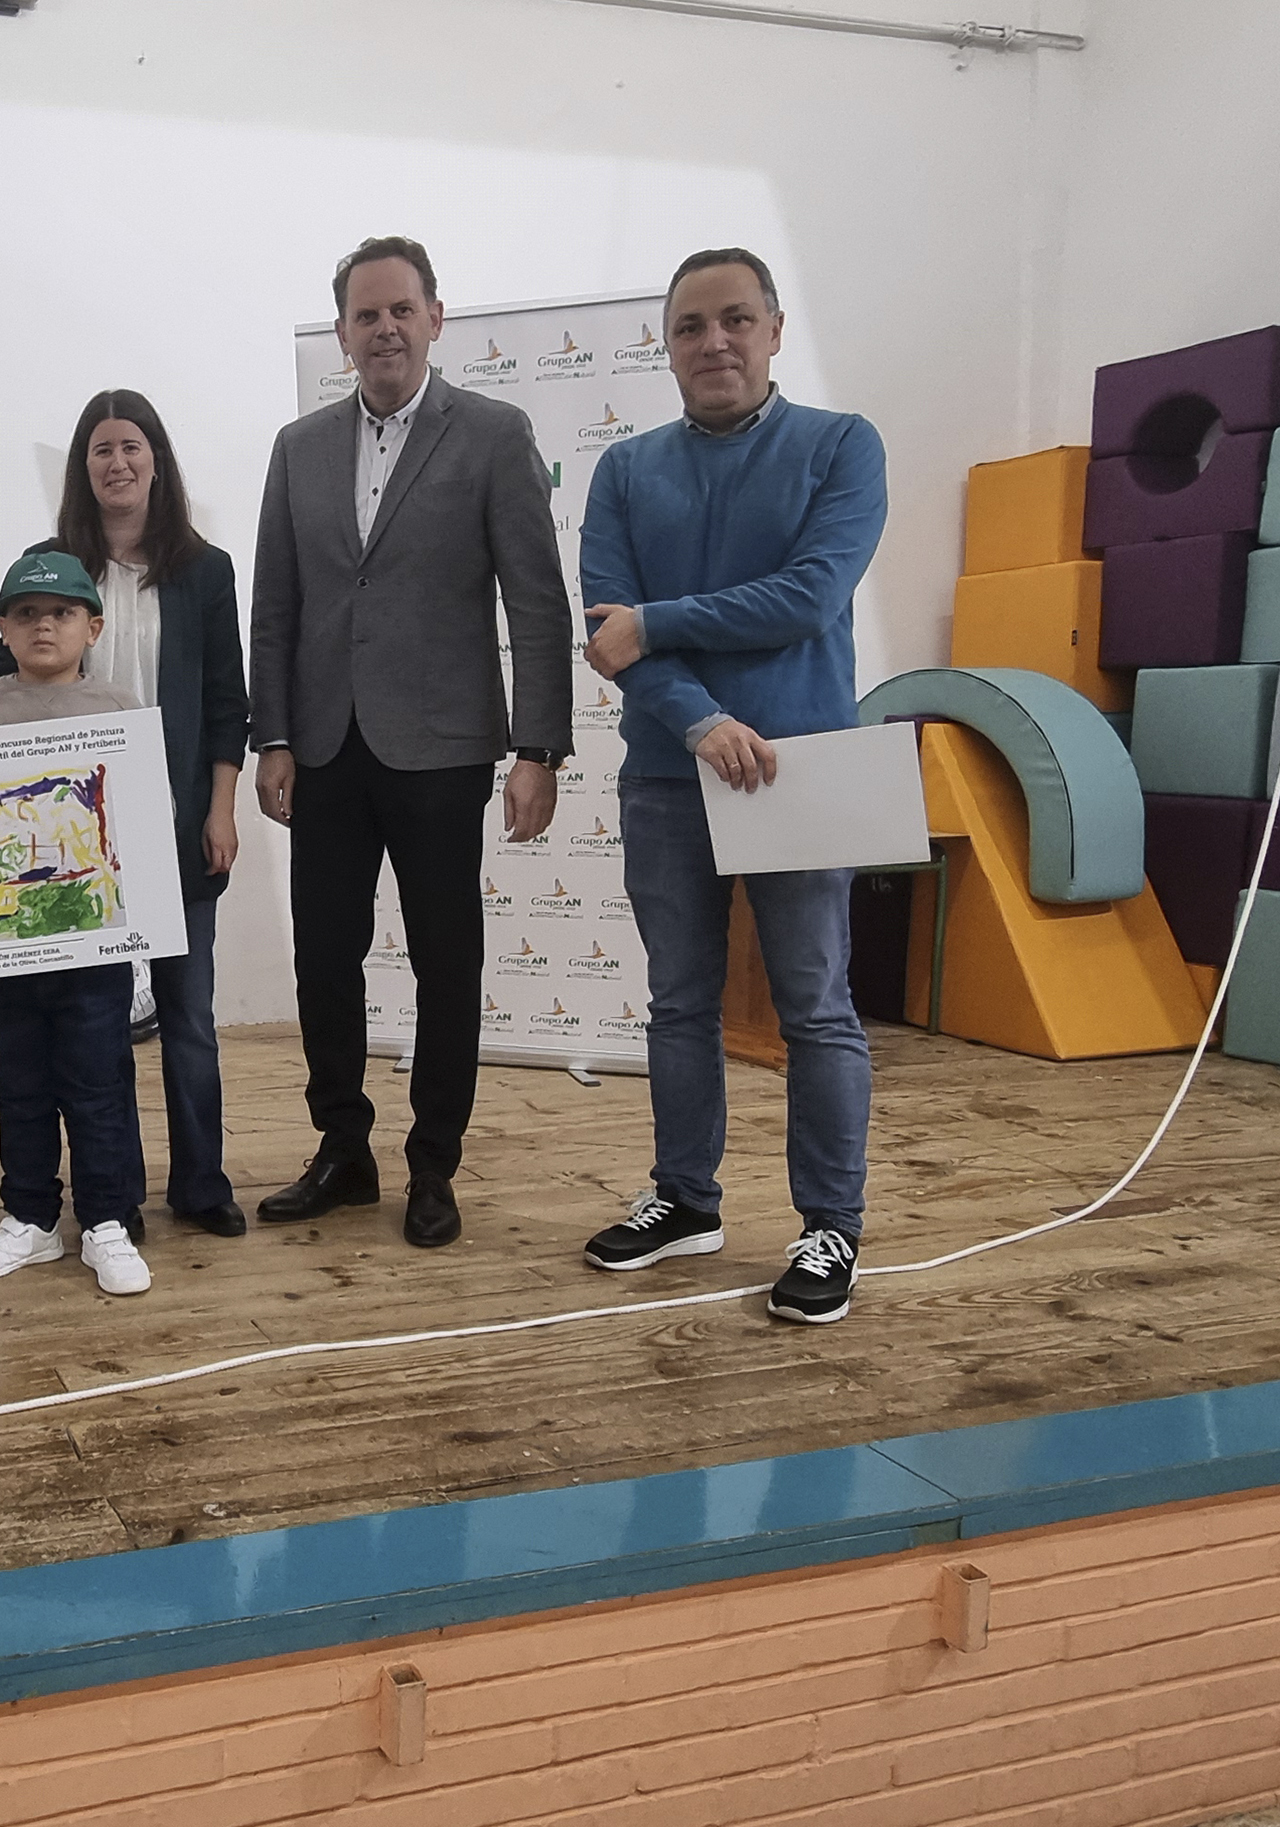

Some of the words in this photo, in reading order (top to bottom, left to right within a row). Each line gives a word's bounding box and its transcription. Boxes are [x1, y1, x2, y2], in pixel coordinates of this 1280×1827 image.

[537, 356, 573, 368] Grupo
[574, 351, 593, 363] AN
[614, 349, 651, 361] Grupo
[463, 363, 497, 375] Grupo
[499, 359, 517, 370] AN
[319, 376, 352, 388] Grupo
[578, 428, 613, 439] Grupo
[615, 424, 634, 435] AN
[43, 572, 58, 580] AN
[573, 709, 606, 719] Grupo
[35, 732, 75, 745] Regional
[77, 731, 89, 739] de
[90, 727, 125, 738] Pintura
[11, 748, 25, 758] del
[26, 746, 56, 757] Grupo
[58, 744, 72, 753] AN
[74, 744, 81, 753] y
[82, 738, 127, 751] Fertiberia
[567, 773, 584, 781] AN
[570, 836, 603, 847] Grupo
[604, 836, 622, 846] AN
[496, 896, 512, 905] AN
[531, 897, 563, 908] Grupo
[565, 898, 582, 907] AN
[99, 940, 150, 956] Fertiberia
[2, 961, 11, 969] de
[498, 955, 530, 967] Grupo
[531, 956, 548, 965] AN
[568, 958, 601, 970] Grupo
[602, 960, 620, 969] AN
[367, 1005, 382, 1014] AN
[399, 1007, 416, 1016] Gru
[495, 1013, 512, 1022] AN
[530, 1014, 562, 1025] Grupo
[563, 1017, 580, 1025] AN
[598, 1018, 631, 1030] Grupo
